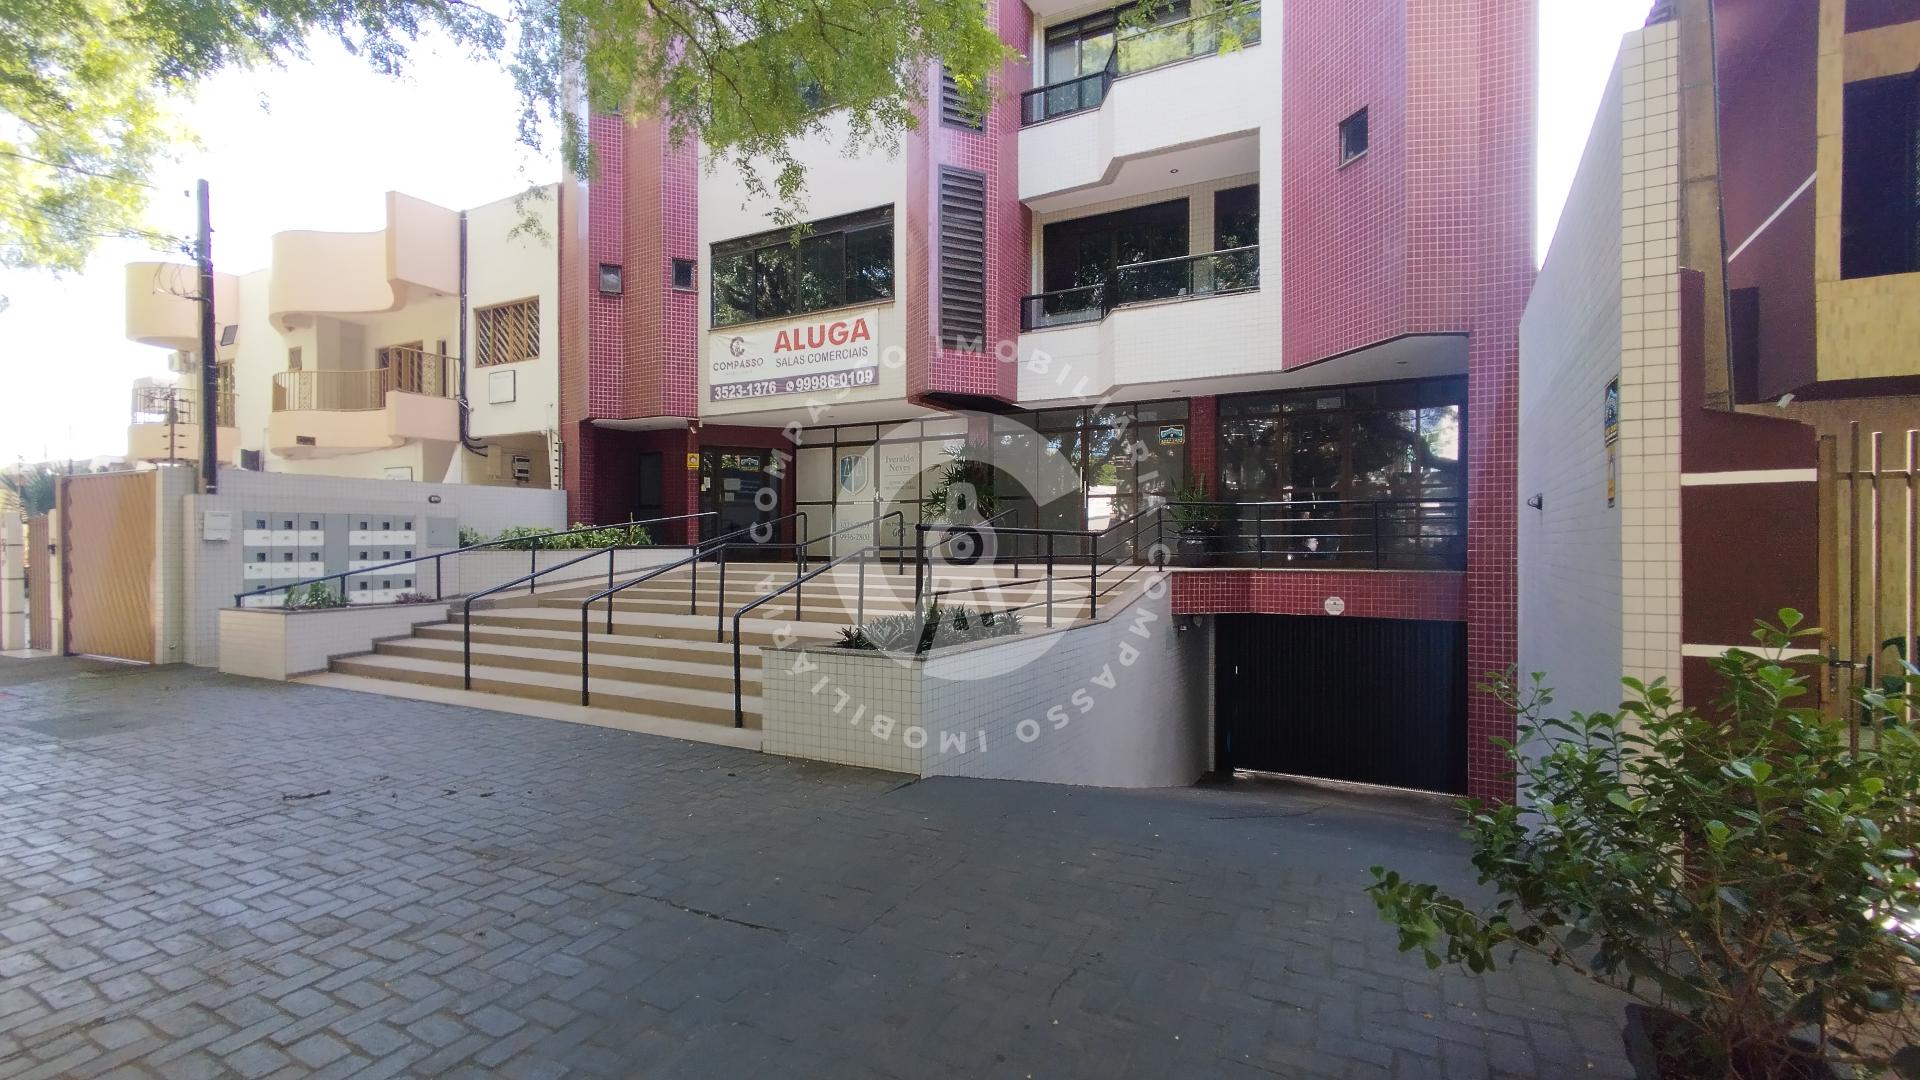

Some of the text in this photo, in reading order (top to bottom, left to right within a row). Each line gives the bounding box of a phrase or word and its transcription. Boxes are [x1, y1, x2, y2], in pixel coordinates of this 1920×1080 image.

[774, 318, 870, 353] ALUGA
[713, 357, 764, 372] COMPASSO
[776, 346, 868, 368] SALAS COMERCIAIS
[715, 369, 874, 400] 3523-1376 99986-0109
